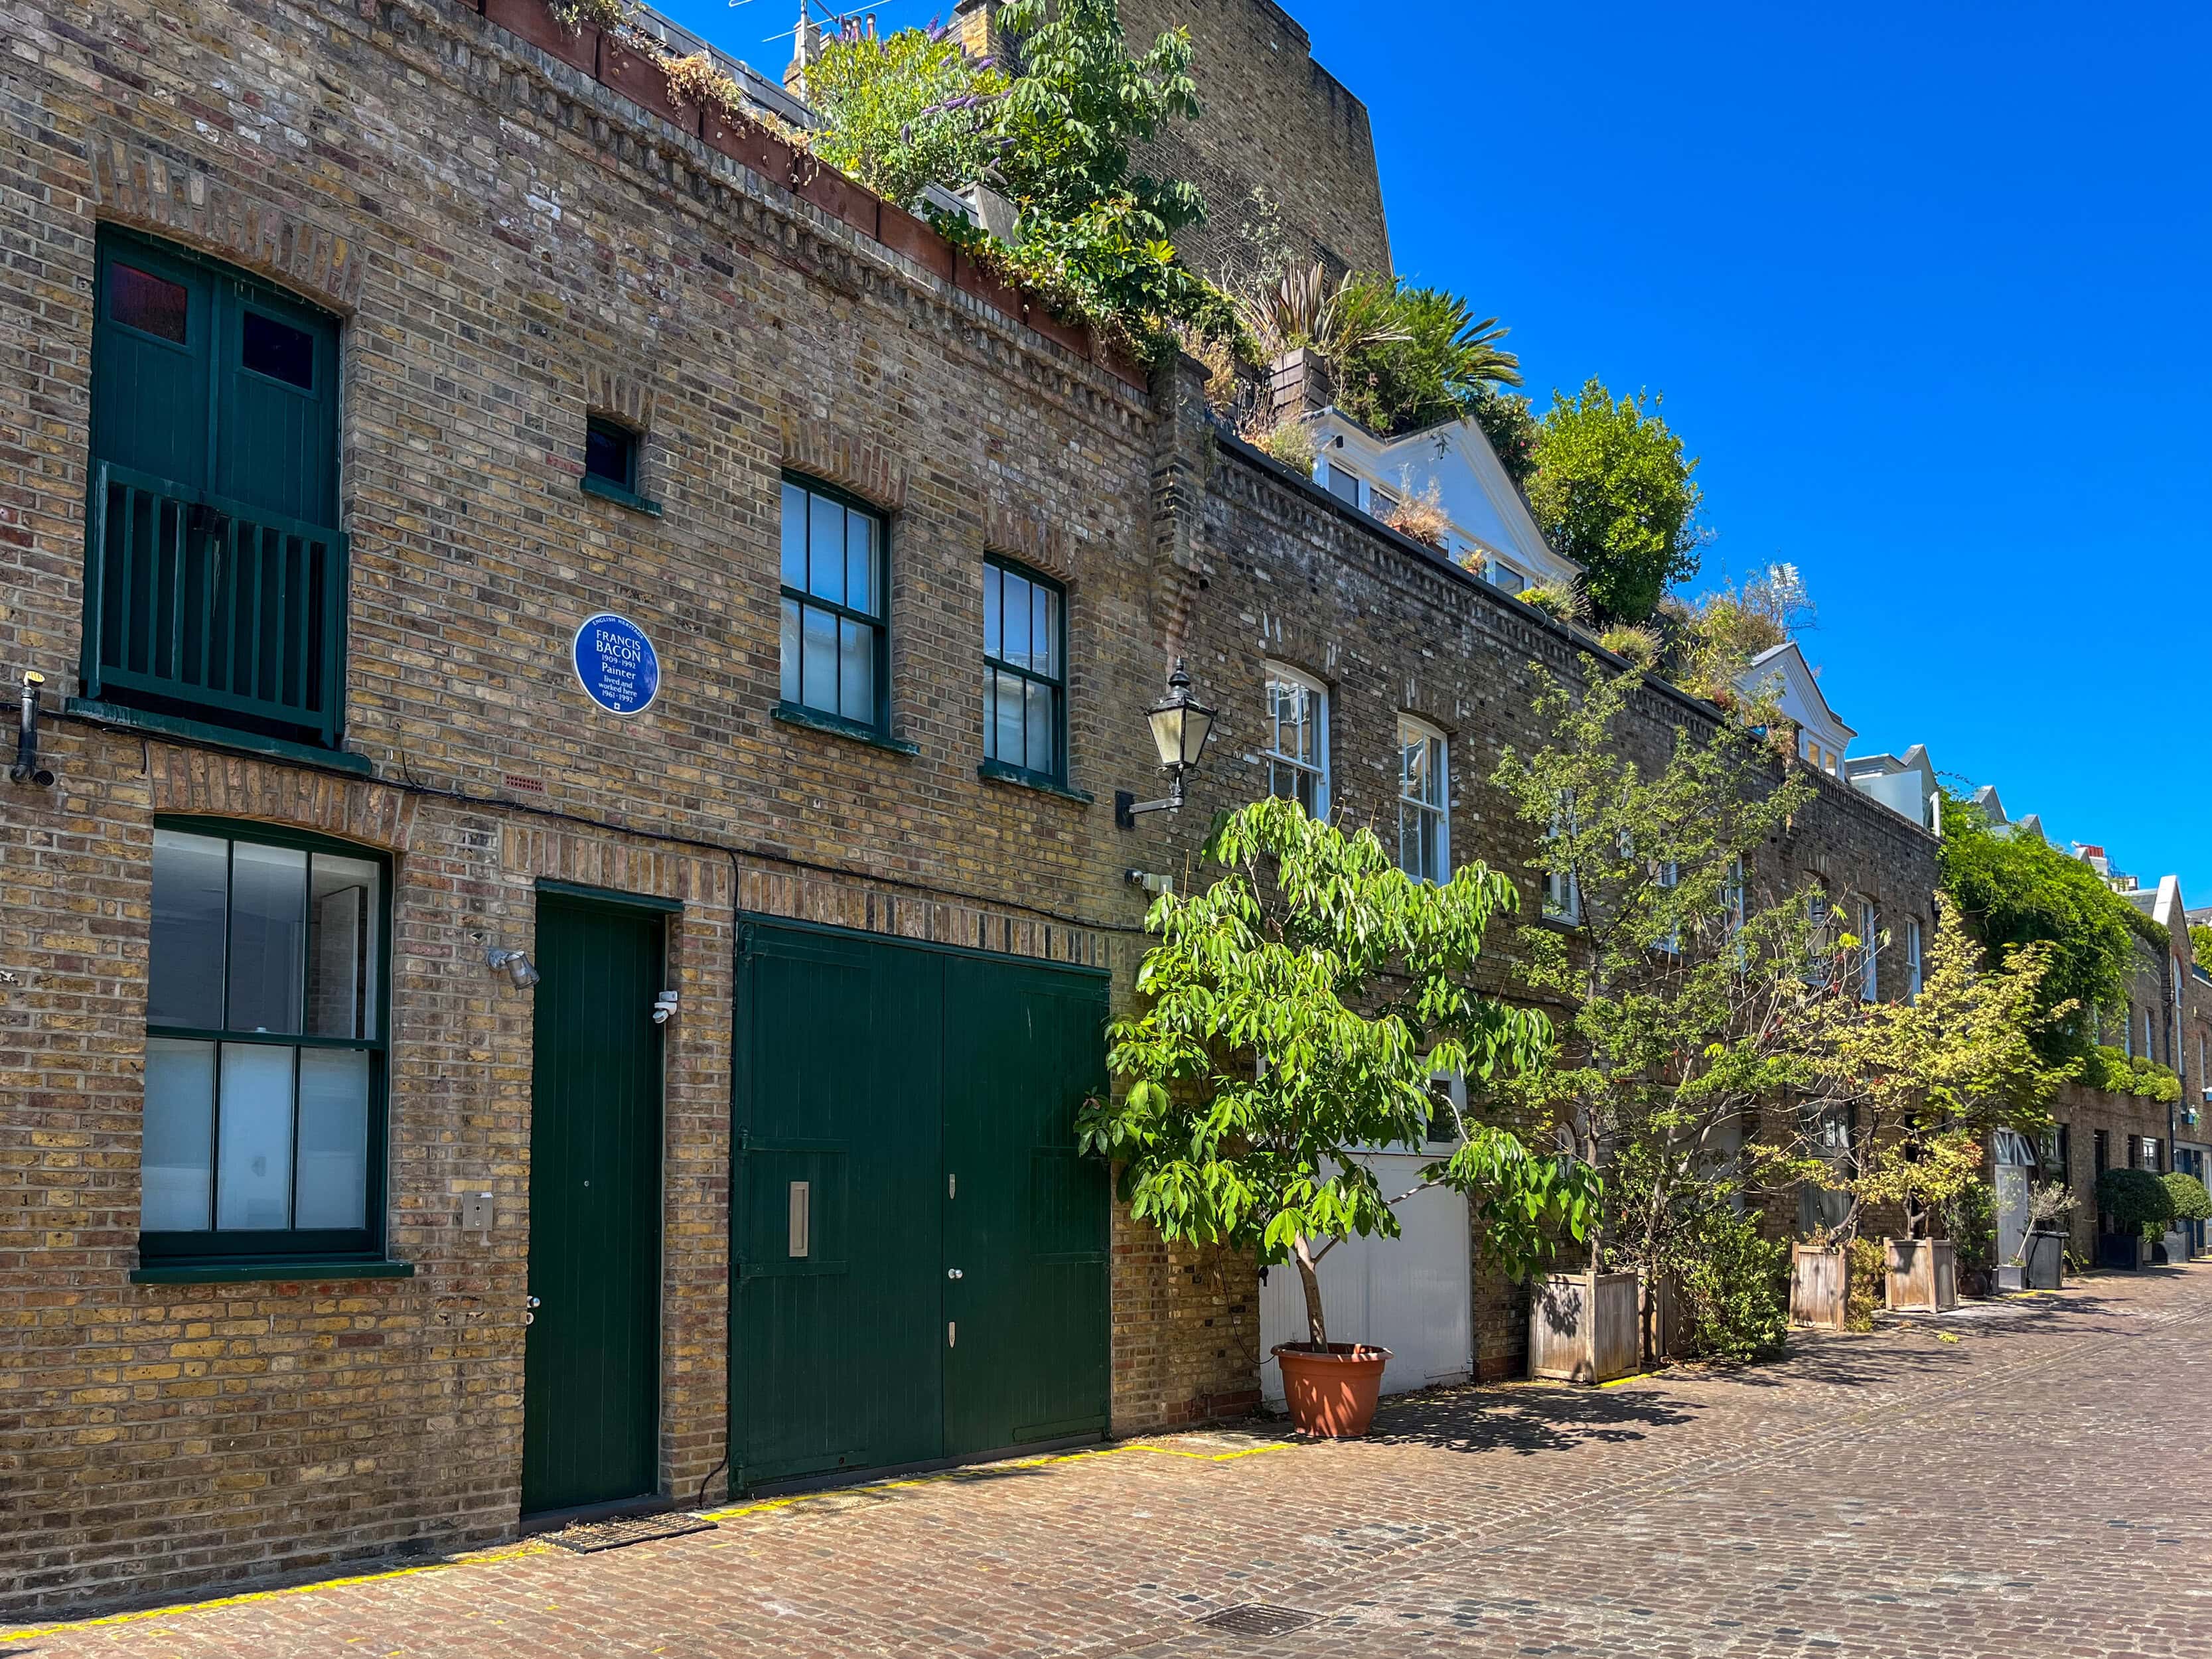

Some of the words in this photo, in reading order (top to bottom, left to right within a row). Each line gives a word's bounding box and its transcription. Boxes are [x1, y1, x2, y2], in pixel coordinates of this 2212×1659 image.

[618, 620, 644, 639] HERITAGE
[596, 630, 640, 650] FRANCIS
[596, 640, 641, 663] BACON
[601, 662, 636, 680] Painter
[598, 682, 622, 694] worked
[623, 686, 638, 697] here
[604, 675, 620, 685] lived
[621, 680, 632, 689] and
[696, 1177, 710, 1204] 7
